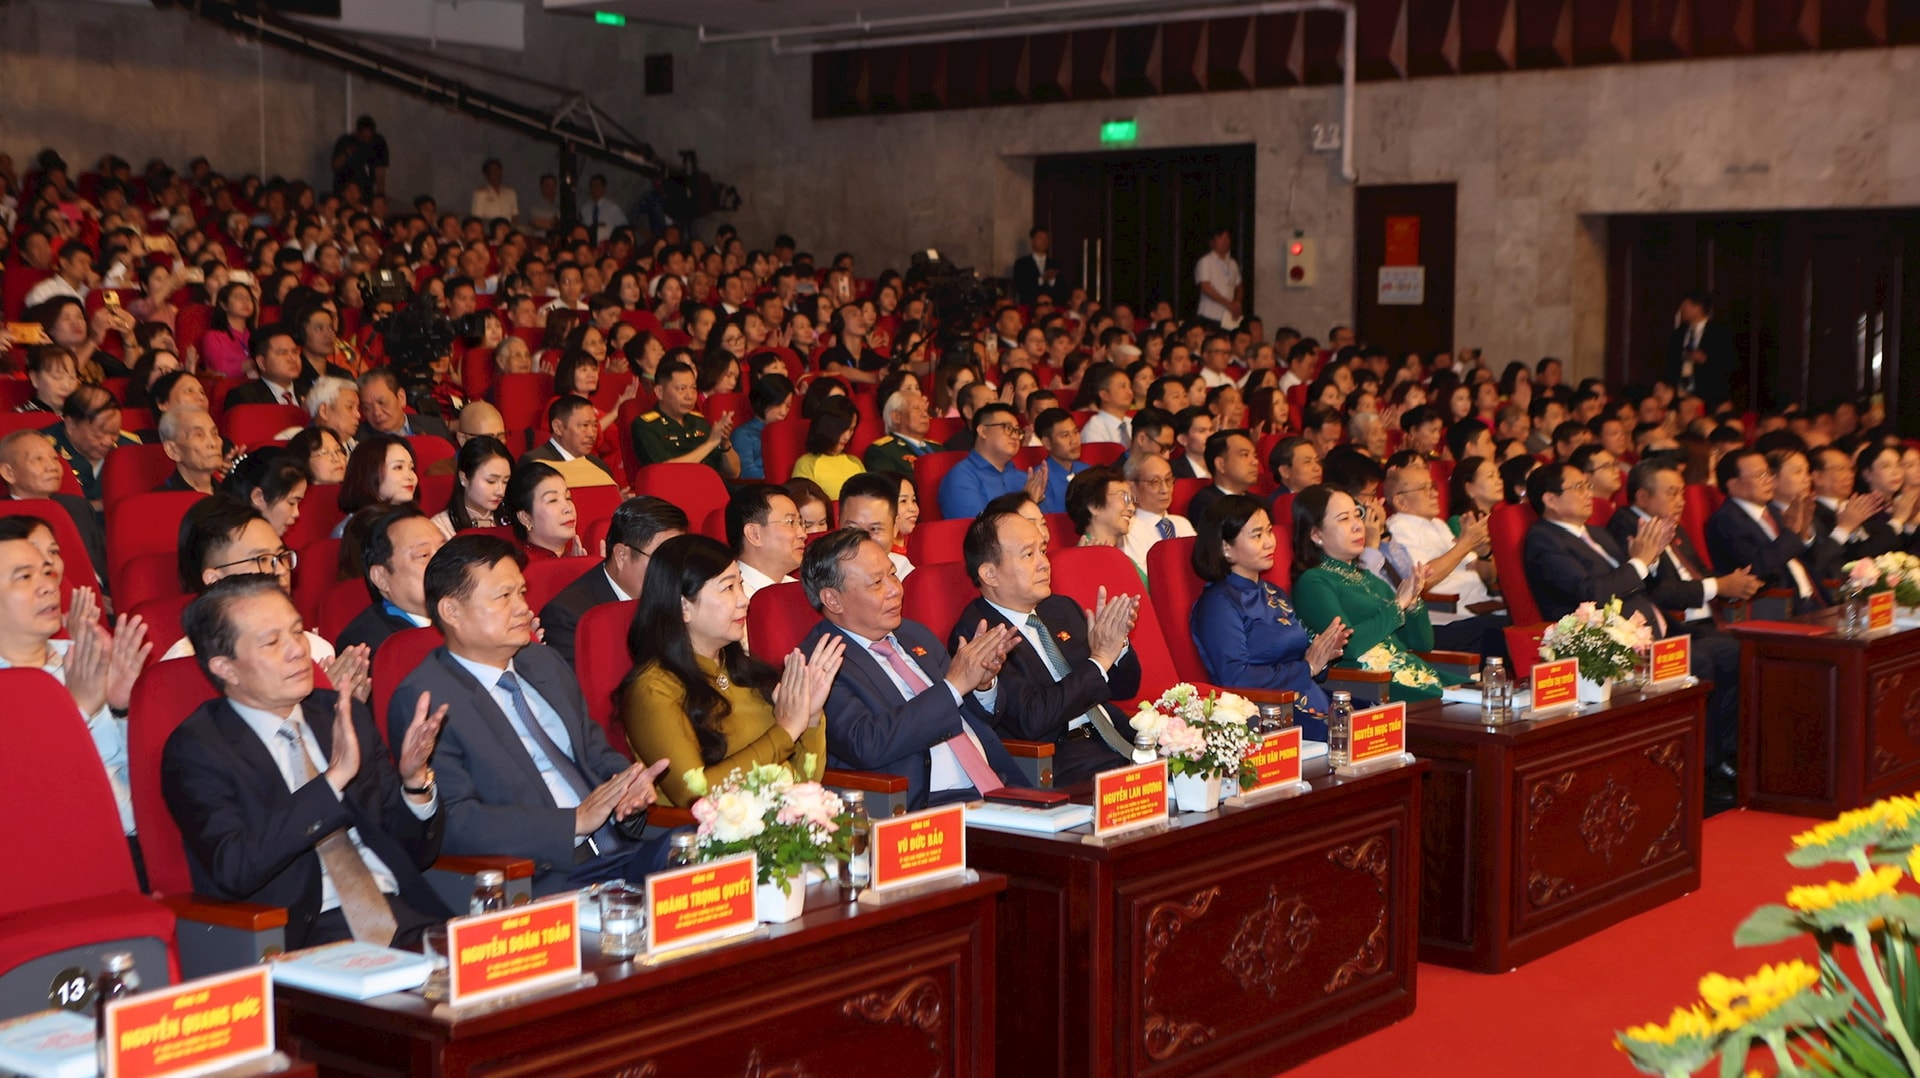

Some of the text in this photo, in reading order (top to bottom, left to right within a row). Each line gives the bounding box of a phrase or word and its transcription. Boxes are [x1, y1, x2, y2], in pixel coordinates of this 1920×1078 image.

[1353, 724, 1374, 741] NGUYỄN
[1374, 722, 1388, 737] NGỌC
[1267, 750, 1278, 764] VĂN
[1279, 746, 1298, 761] PHONG
[1103, 785, 1128, 806] NGUYỄN
[1129, 785, 1141, 799] LAN
[1142, 780, 1163, 796] HƯƠNG
[897, 827, 944, 854] VŨ ĐỨC BẢO
[655, 893, 689, 917] HOÀNG
[689, 886, 721, 909] TRỌNG
[721, 875, 751, 902] QUYẾT
[460, 934, 508, 966] NGUYỄN
[57, 976, 86, 1006] 13
[120, 1015, 180, 1051] NGUYỄN
[181, 1005, 231, 1036] QUANG
[230, 994, 262, 1024] ĐỨC
